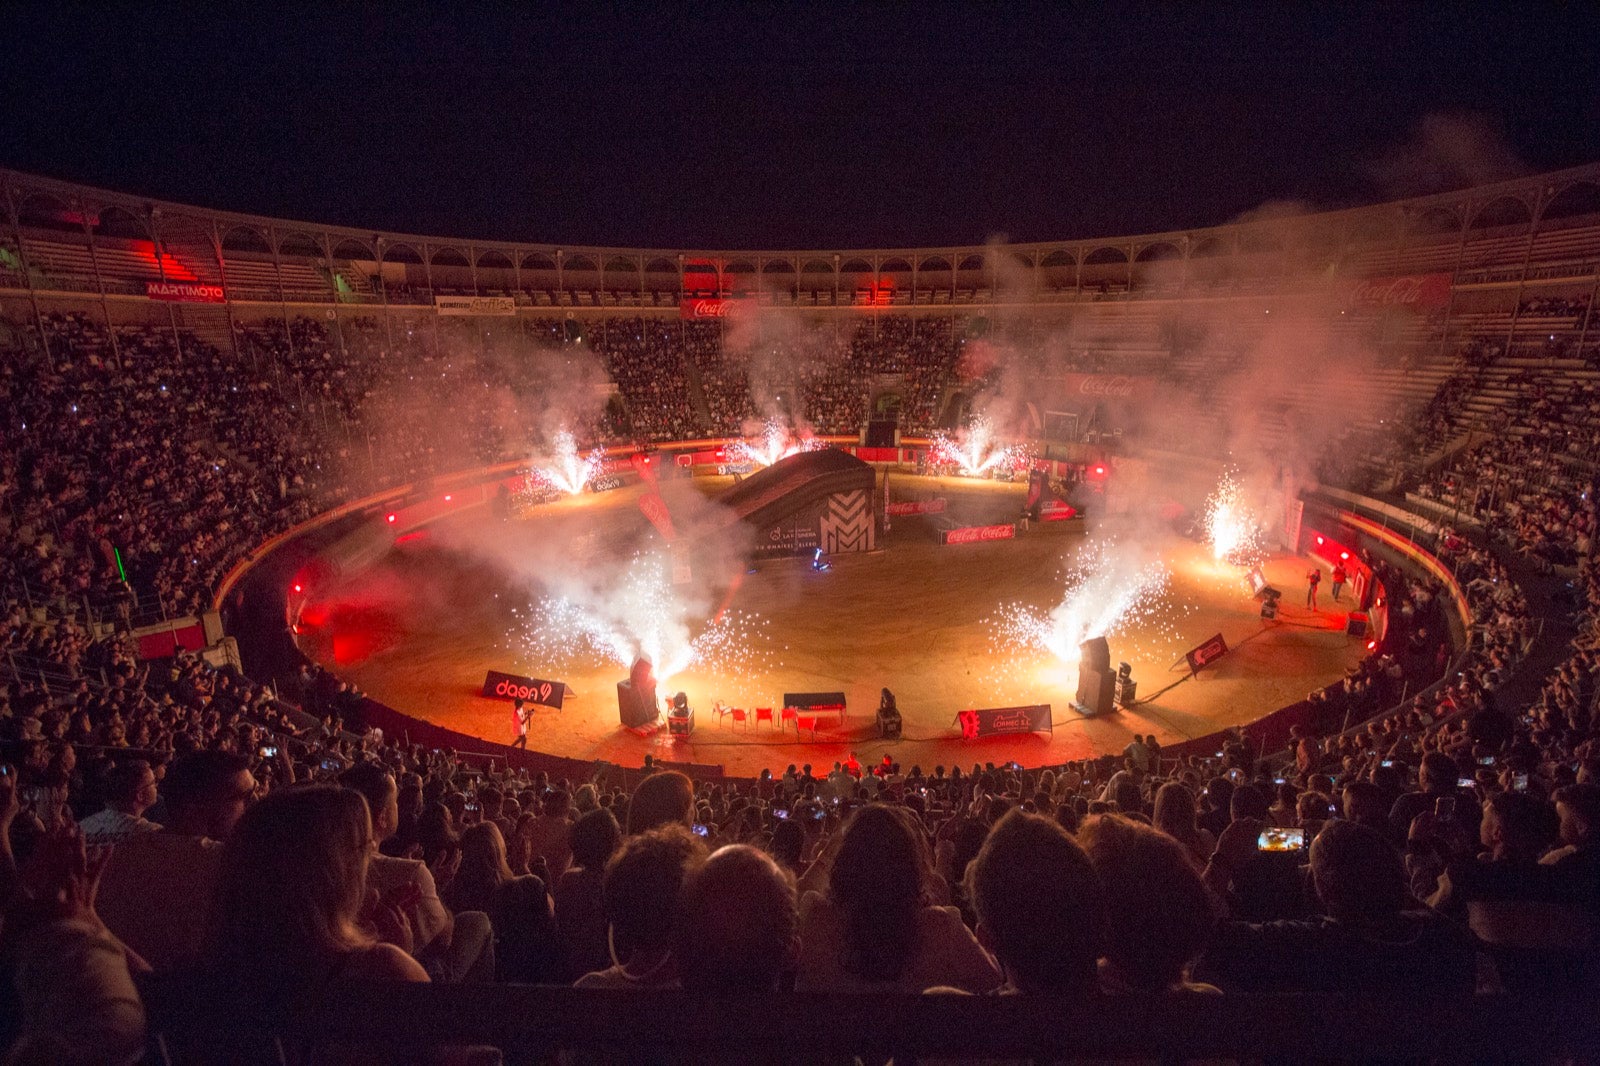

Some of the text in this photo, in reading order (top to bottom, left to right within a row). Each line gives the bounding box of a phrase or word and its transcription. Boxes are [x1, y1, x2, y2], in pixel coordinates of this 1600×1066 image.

[147, 283, 224, 297] MARTIMOTO
[947, 523, 1011, 543] Coca-Cola Coca-Cola
